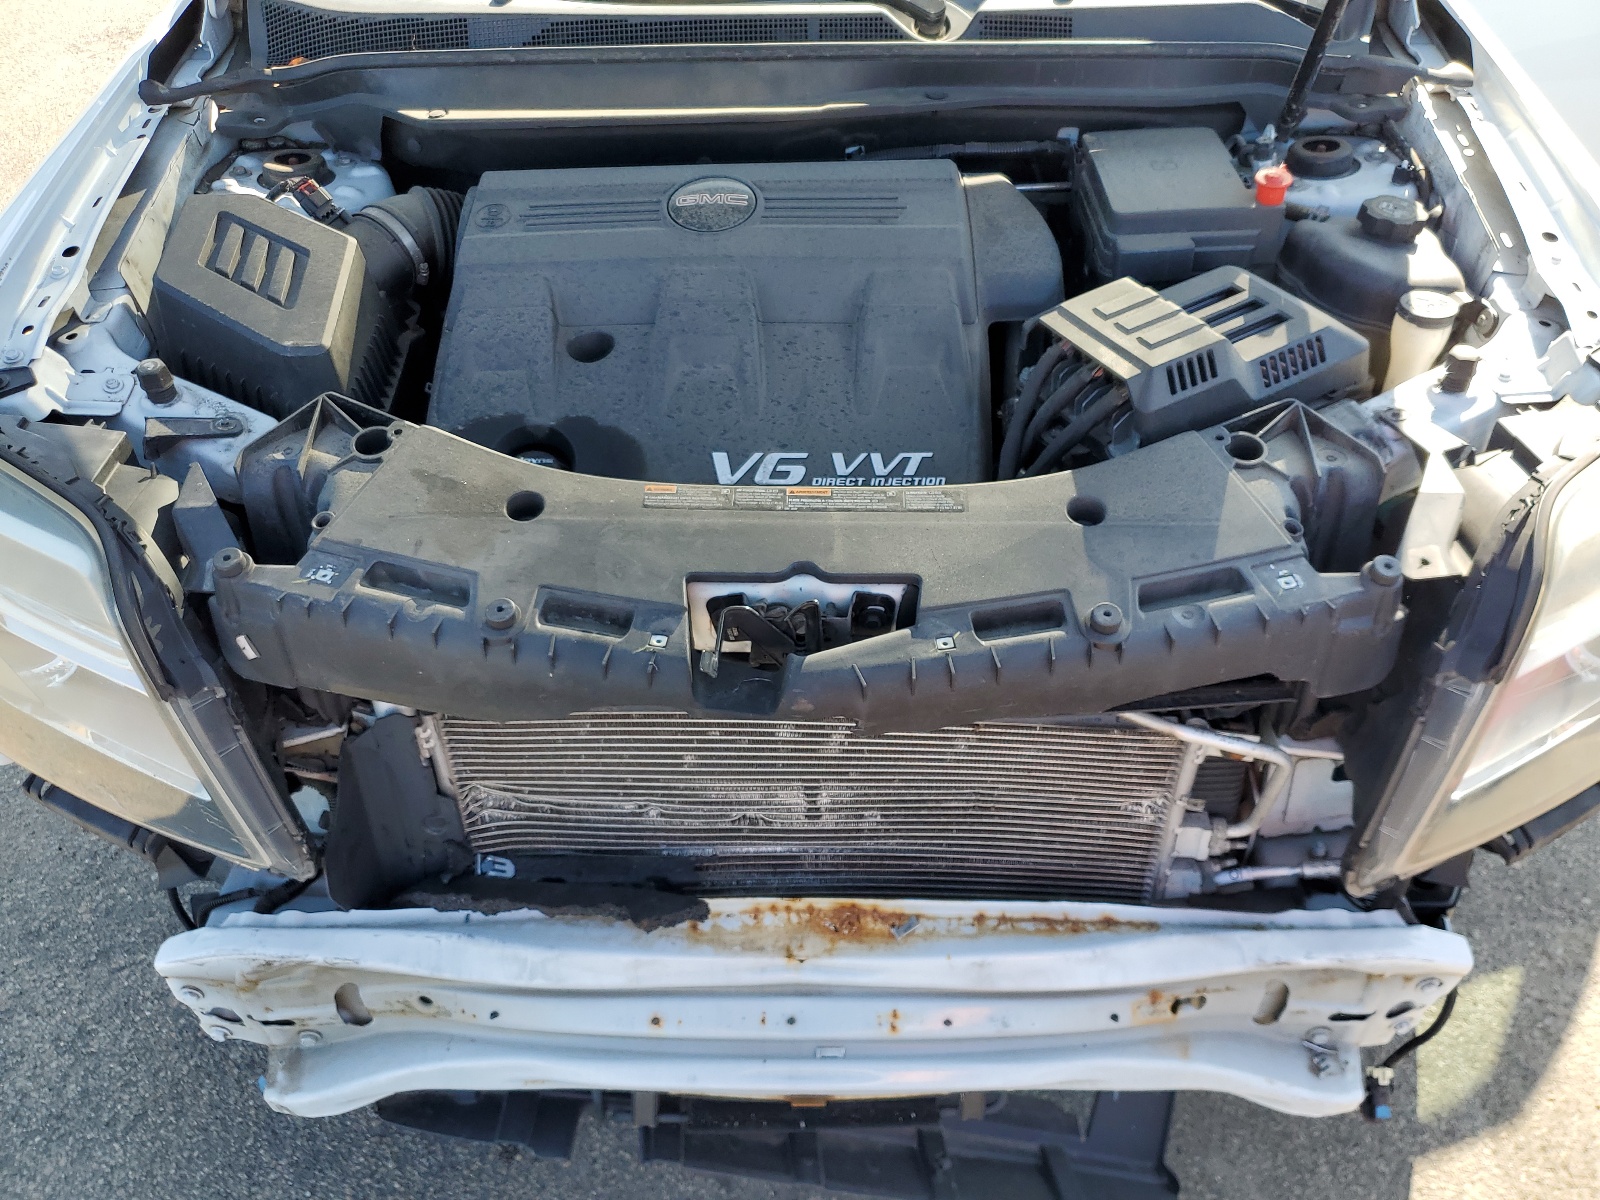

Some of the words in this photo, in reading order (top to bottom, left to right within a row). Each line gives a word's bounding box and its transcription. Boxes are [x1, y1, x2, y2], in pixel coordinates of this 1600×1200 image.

[676, 193, 749, 206] GMC
[711, 451, 810, 485] V6
[831, 452, 934, 476] VVT
[812, 477, 866, 486] DIRECT
[870, 477, 947, 486] INJECTION
